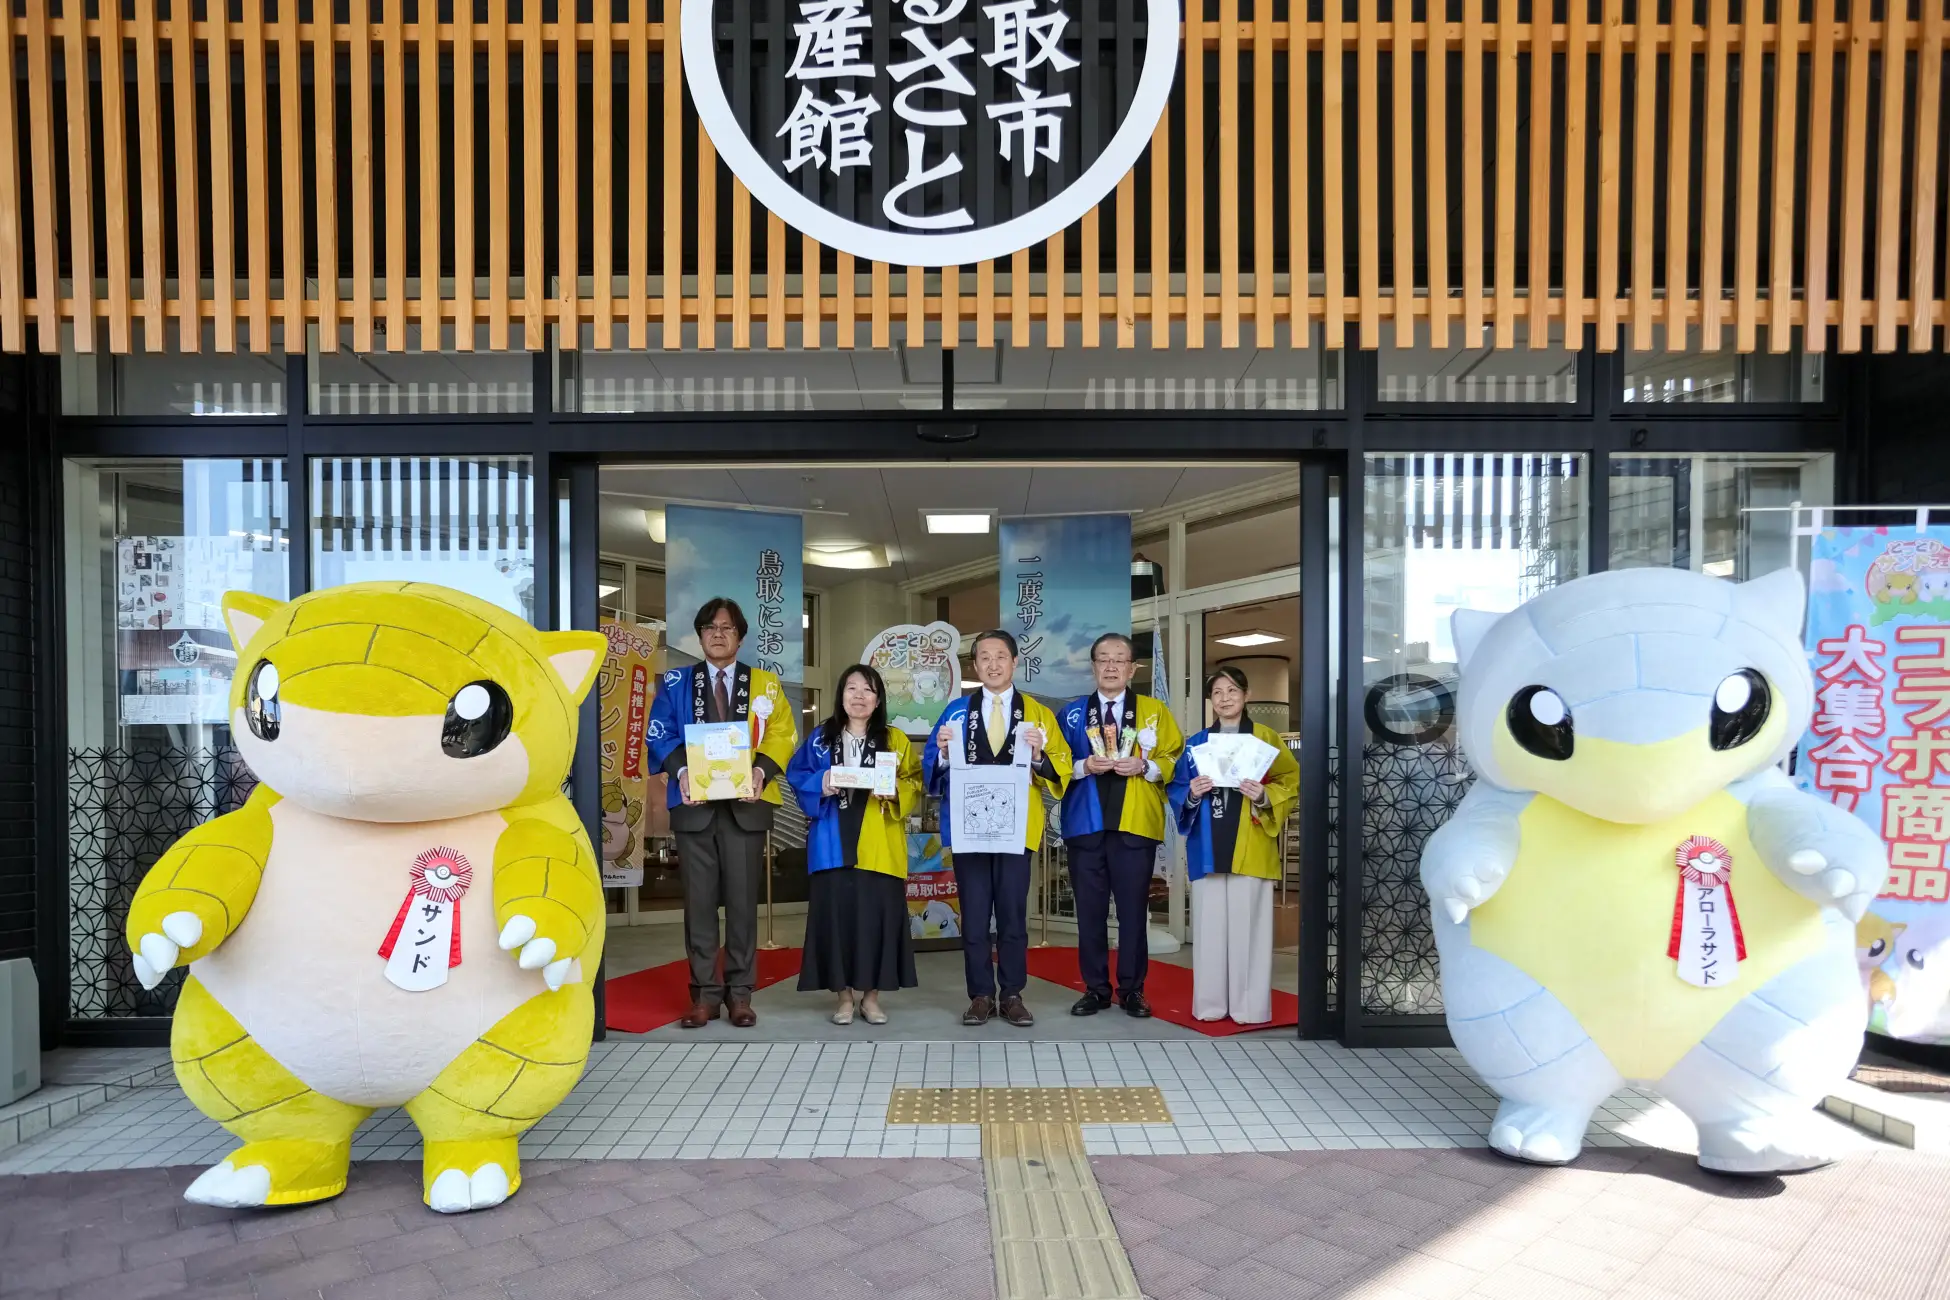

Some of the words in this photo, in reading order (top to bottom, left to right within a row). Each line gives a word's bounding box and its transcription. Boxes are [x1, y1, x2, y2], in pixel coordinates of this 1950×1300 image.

[776, 0, 881, 177] 産館
[981, 0, 1081, 177] 取市
[756, 548, 785, 676] 鳥取におい
[883, 633, 931, 651] とっとり
[1016, 555, 1043, 682] 二度サンド
[626, 669, 644, 771] 鳥取推しポケモン
[736, 673, 749, 714] さんど
[1878, 626, 1950, 901] コラボ商品
[411, 904, 442, 973] サンド
[905, 881, 958, 897] 鳥取にお
[1697, 887, 1718, 985] アローラサンド
